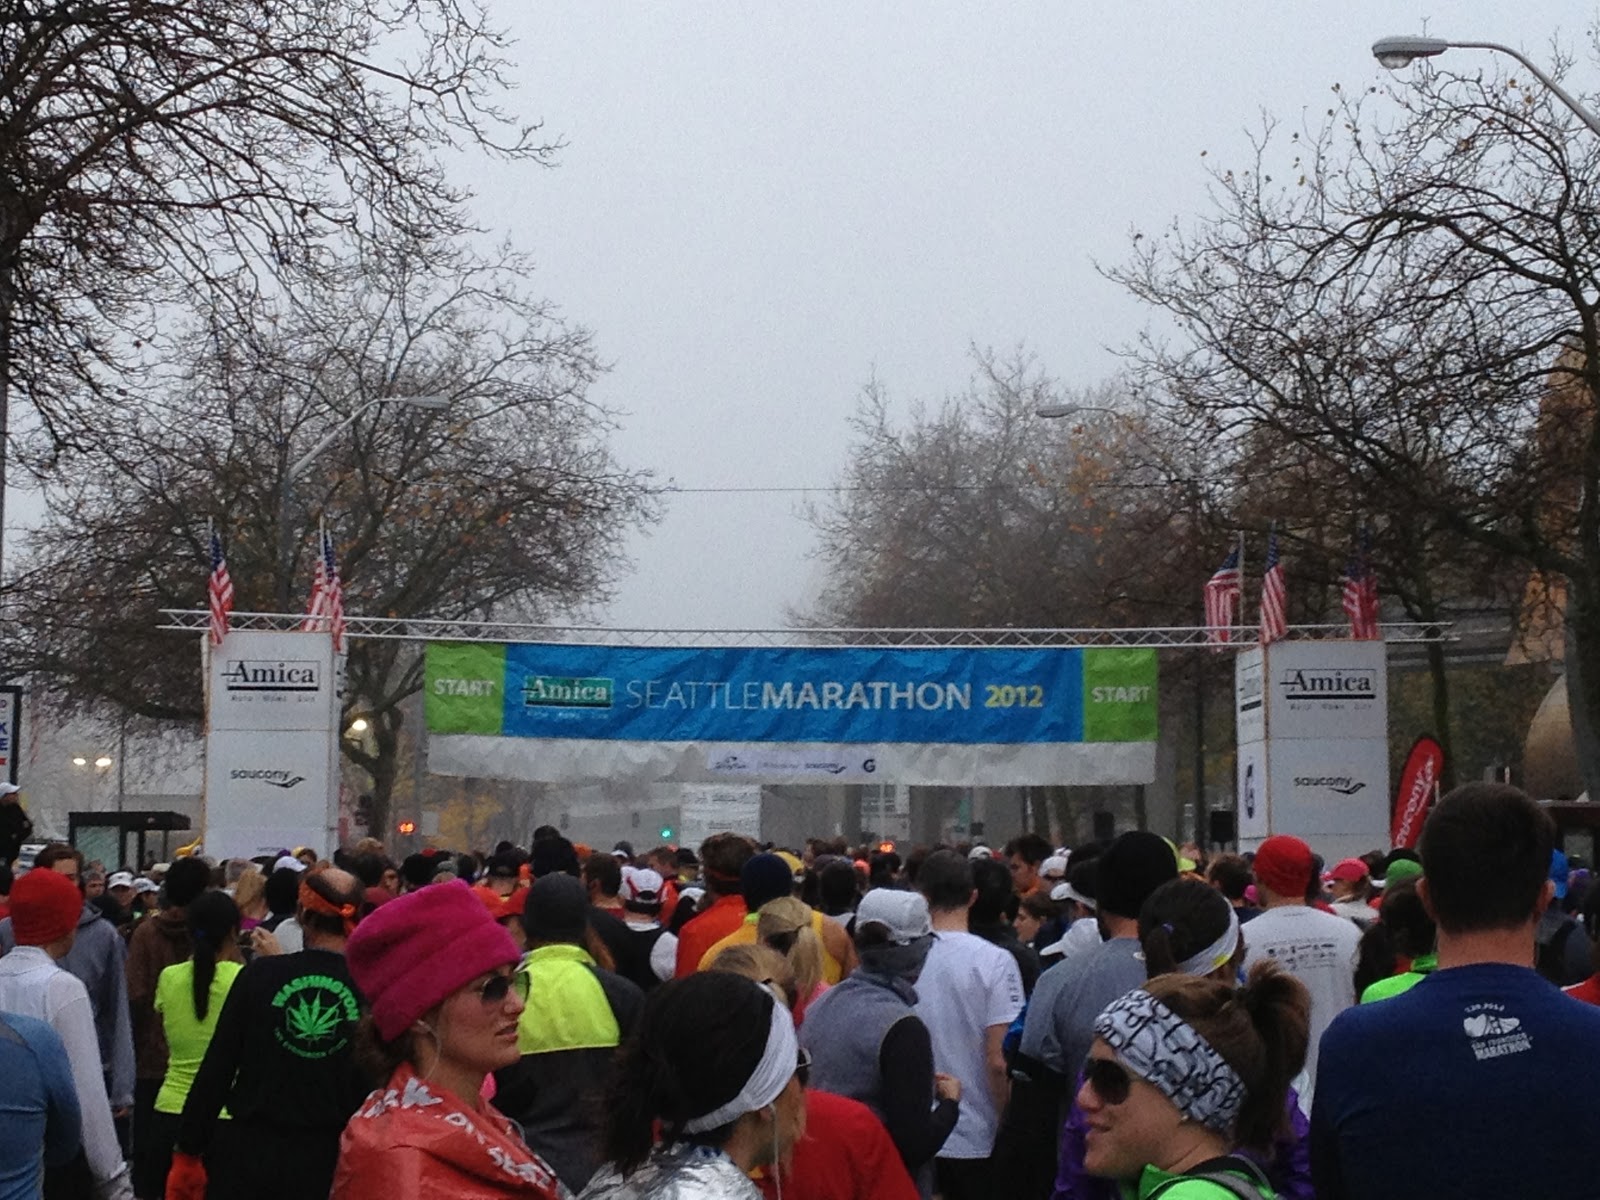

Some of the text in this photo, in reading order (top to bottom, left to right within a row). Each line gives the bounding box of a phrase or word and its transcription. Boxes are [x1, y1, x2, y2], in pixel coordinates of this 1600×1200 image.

[221, 660, 315, 683] Amica
[1280, 669, 1371, 691] Amica
[433, 679, 495, 696] START
[521, 678, 608, 701] Amica
[984, 684, 1044, 708] 2012
[1091, 685, 1151, 703] START
[230, 768, 291, 781] saucony
[1294, 776, 1353, 788] saucony
[272, 975, 360, 1020] WASHINGTON
[1475, 1040, 1531, 1060] MARATHON
